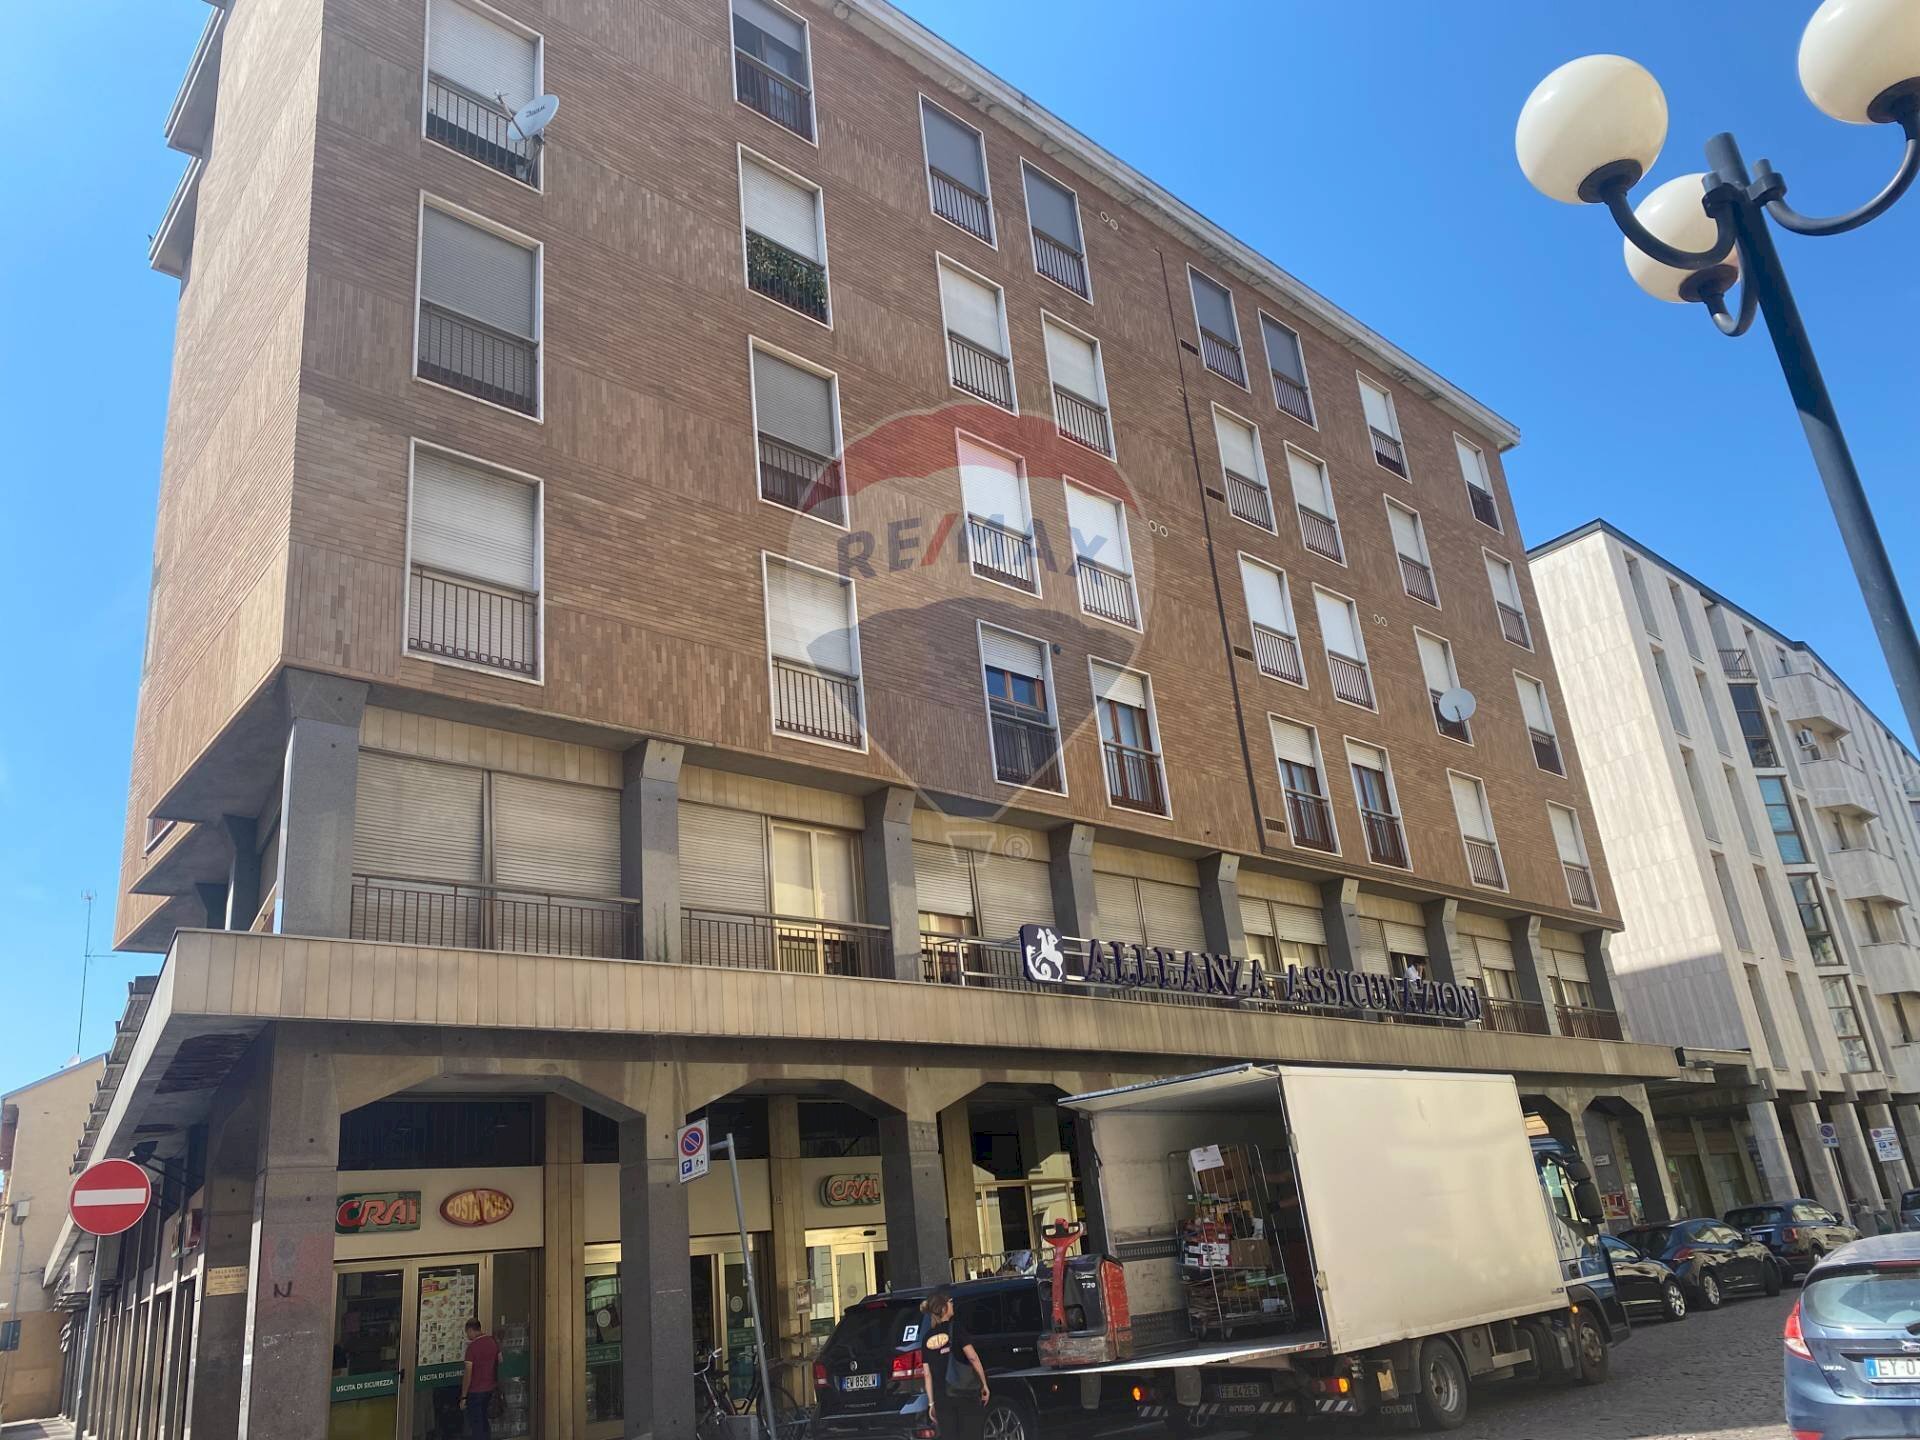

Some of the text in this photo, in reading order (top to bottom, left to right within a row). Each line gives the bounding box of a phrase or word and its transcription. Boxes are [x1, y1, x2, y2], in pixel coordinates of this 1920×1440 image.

[1084, 938, 1484, 1020] ALLEANZA ASSICURAZIONI
[336, 1198, 417, 1227] CRAI
[446, 1191, 481, 1222] COSTA
[905, 1327, 916, 1340] P
[336, 1384, 356, 1393] USCITA
[364, 1379, 394, 1389] SICUREZZA
[419, 1373, 438, 1382] USCITA
